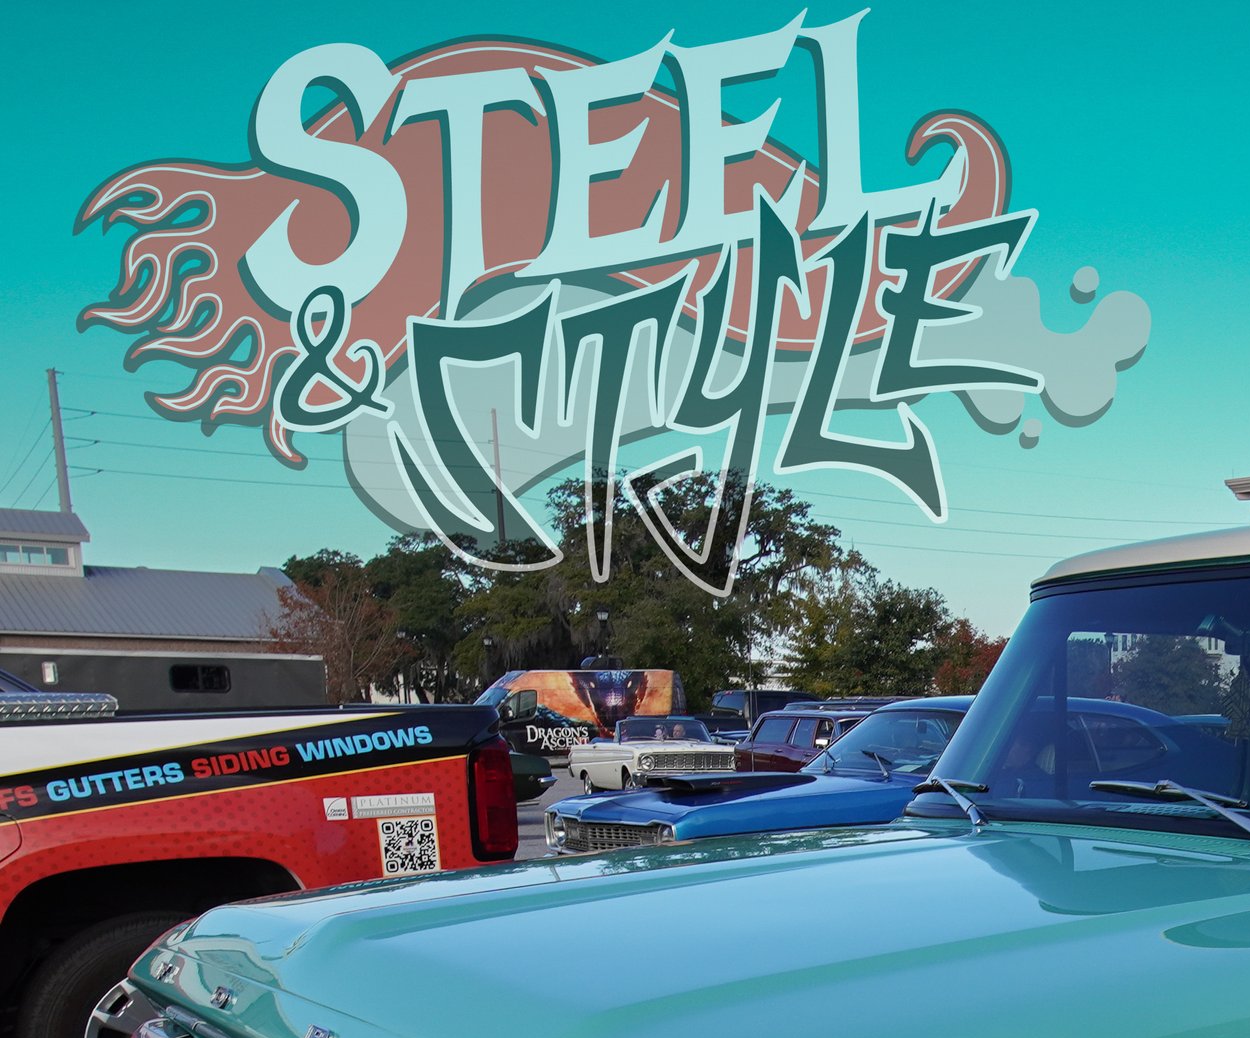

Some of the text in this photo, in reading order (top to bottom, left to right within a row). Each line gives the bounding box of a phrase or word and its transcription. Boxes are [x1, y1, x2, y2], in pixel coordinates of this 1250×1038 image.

[526, 724, 589, 743] DRAGON'S
[540, 735, 590, 751] ASCENT
[46, 762, 185, 802] GUTTERS
[191, 746, 290, 779] SIDING
[295, 725, 433, 762] WINDOWS
[360, 795, 432, 808] PLATINUM
